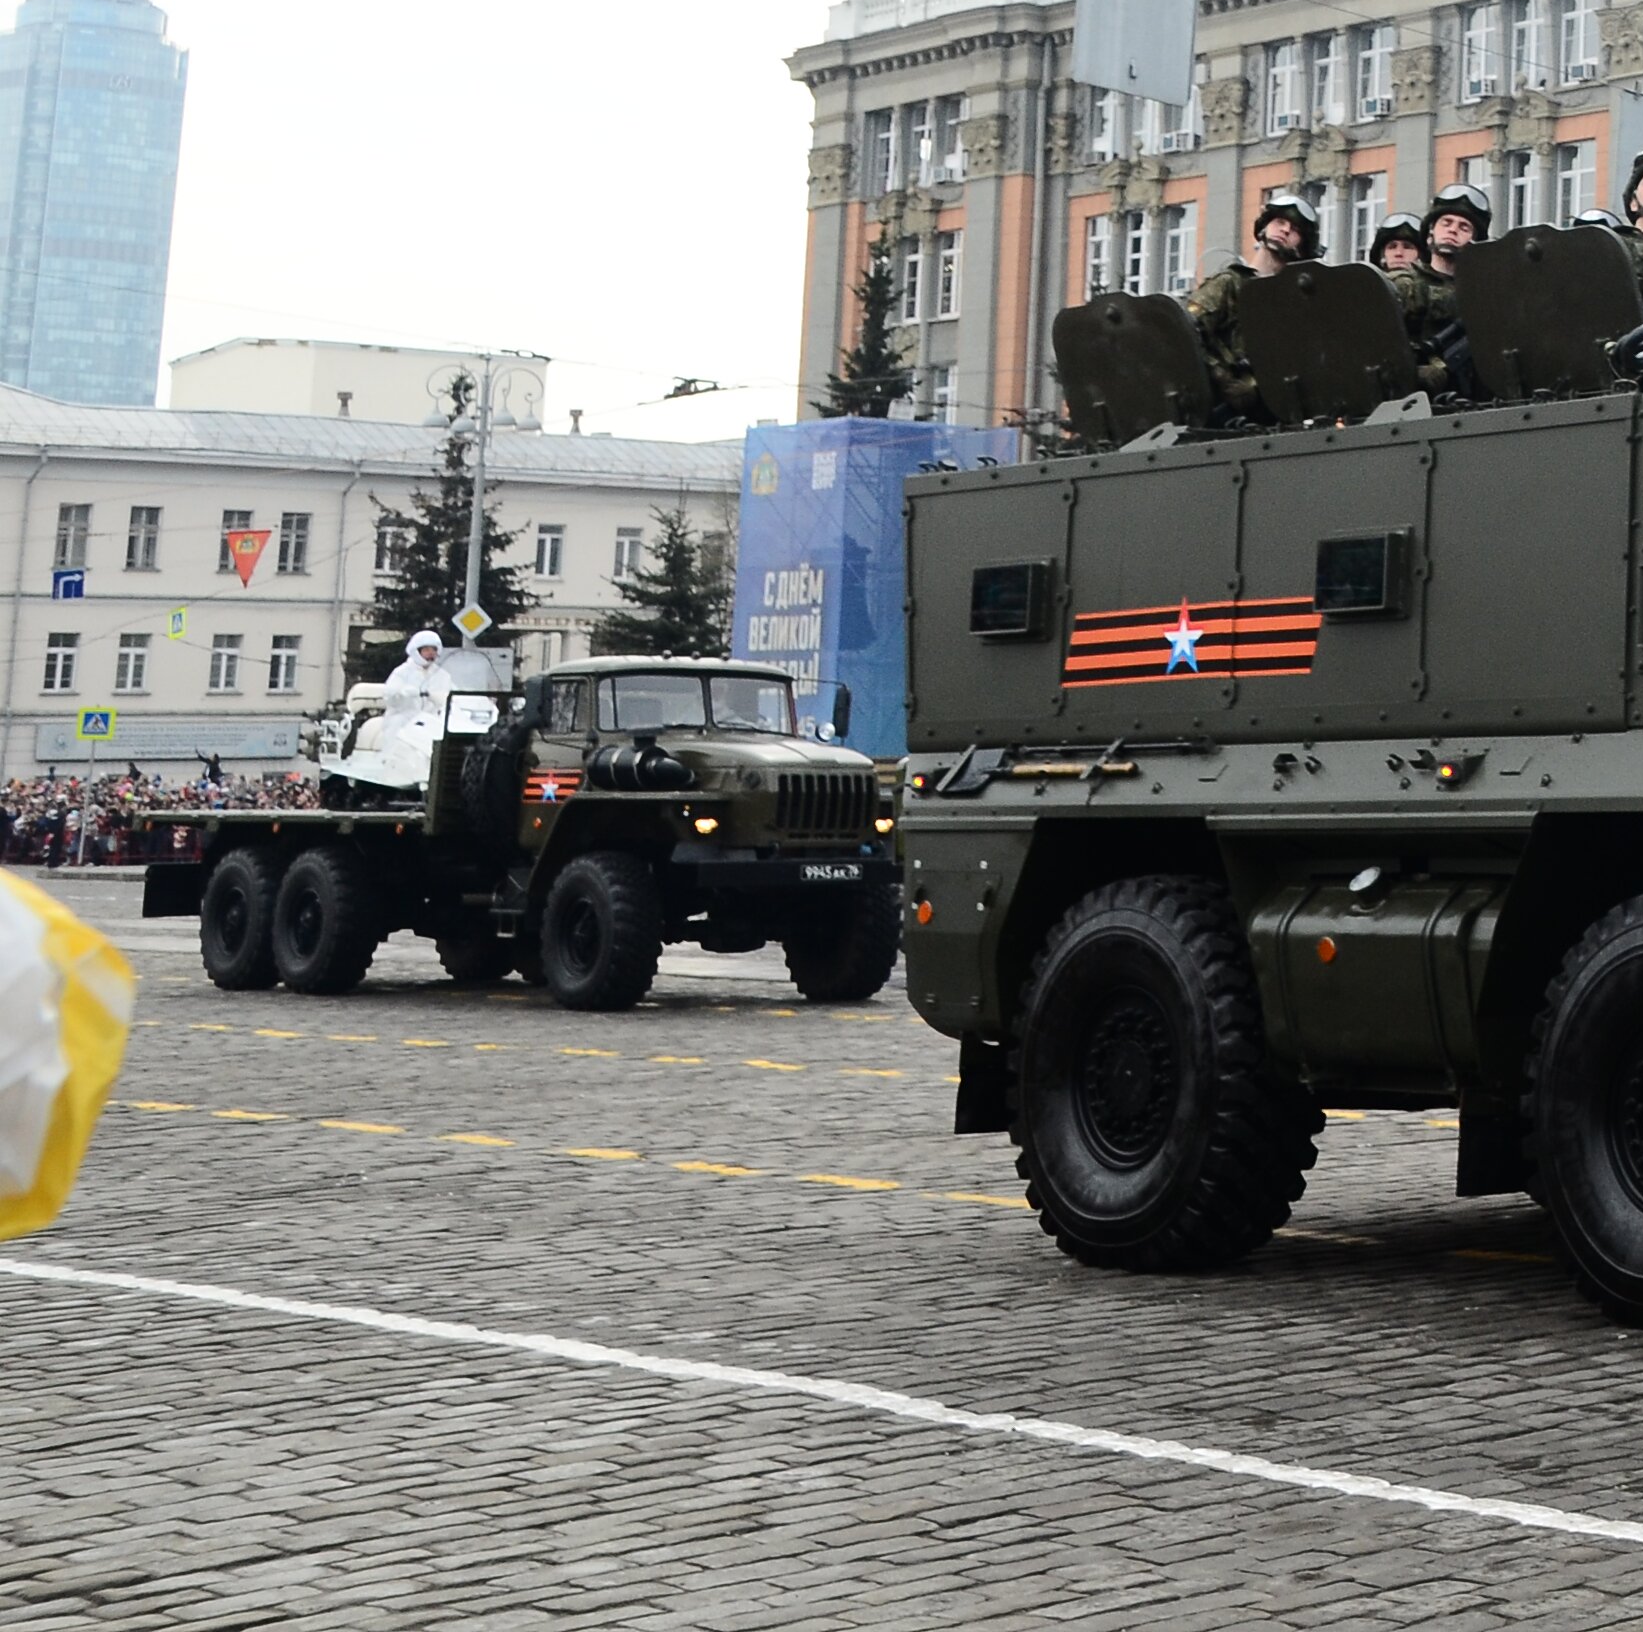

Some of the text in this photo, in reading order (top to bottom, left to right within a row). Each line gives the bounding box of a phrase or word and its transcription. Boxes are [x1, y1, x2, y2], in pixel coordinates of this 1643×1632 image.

[764, 562, 824, 610] С ДНЁМ
[748, 607, 822, 651] ВЕЛИКОЙ
